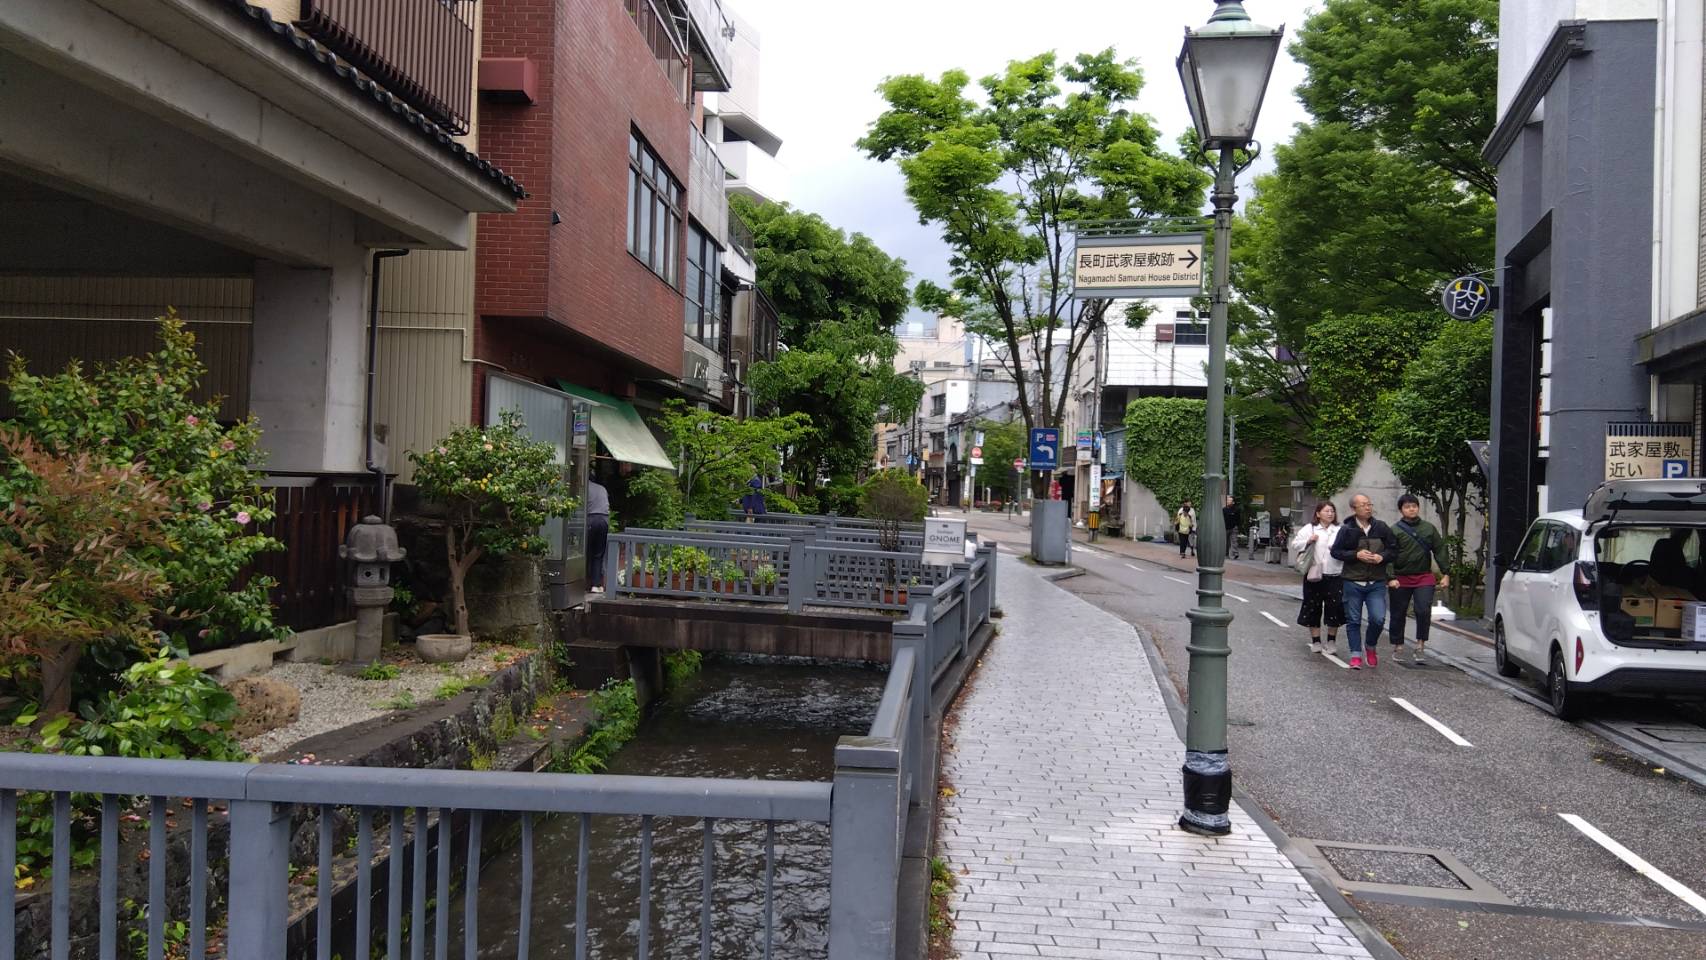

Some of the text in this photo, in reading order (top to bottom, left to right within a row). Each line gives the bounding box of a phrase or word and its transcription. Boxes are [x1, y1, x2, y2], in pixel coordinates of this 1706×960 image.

[1080, 252, 1175, 269] 長町武家屋敷跡
[1078, 272, 1198, 285] Nagamachi Samurai House District
[1609, 441, 1690, 458] 武家屋敷に
[1609, 462, 1643, 478] 近い
[1667, 463, 1683, 478] P
[929, 534, 961, 544] GNOME
